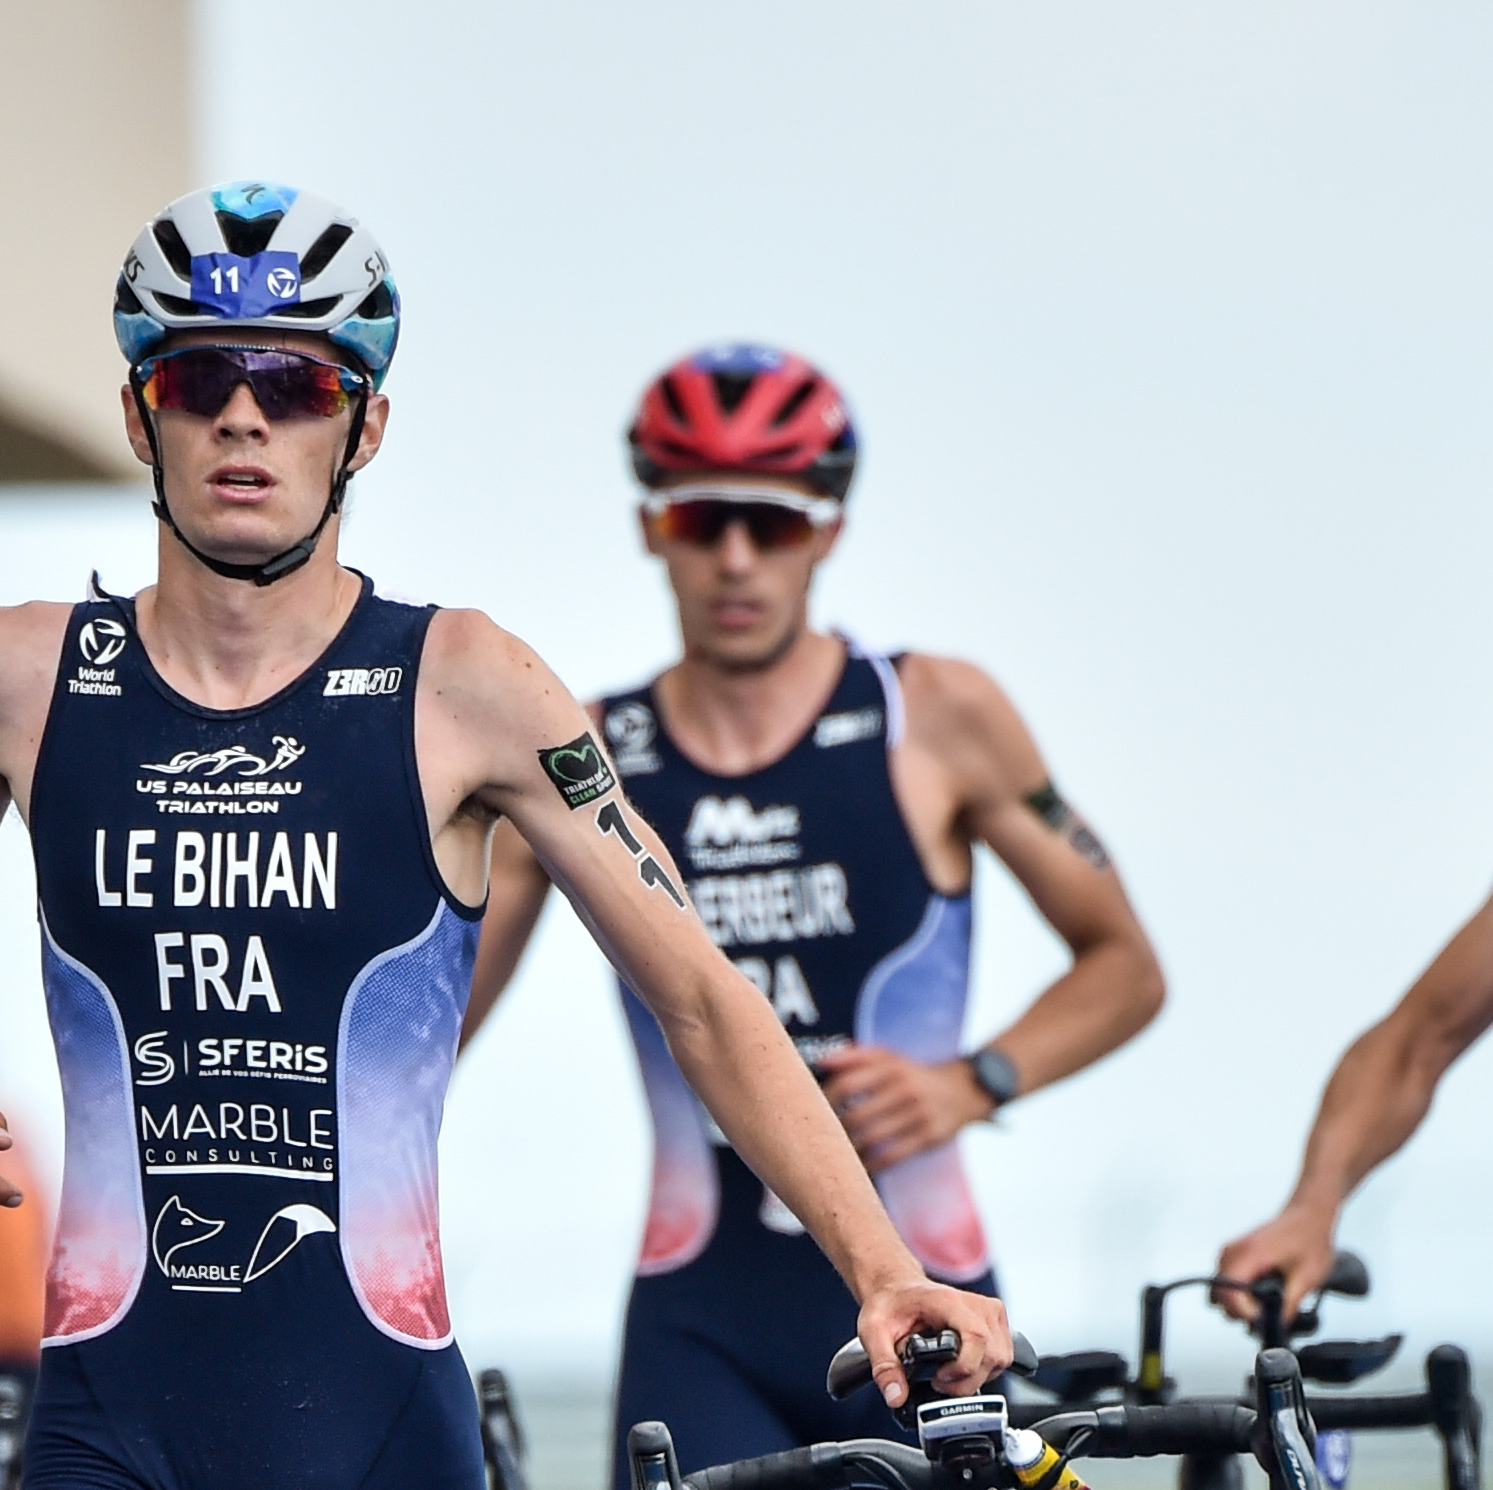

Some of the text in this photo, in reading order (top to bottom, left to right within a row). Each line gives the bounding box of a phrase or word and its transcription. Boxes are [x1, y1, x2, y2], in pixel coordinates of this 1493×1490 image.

[210, 266, 240, 295] 11
[78, 666, 116, 681] World
[68, 679, 122, 696] Triathlon
[136, 780, 303, 795] US PALAISEAU
[156, 800, 280, 814] TRIATHLON
[594, 799, 687, 911] 11
[95, 829, 338, 909] LE BIHAN
[153, 931, 282, 1014] FRA
[141, 1102, 334, 1149] MARBLE
[145, 1148, 334, 1170] CONSULTING
[170, 1264, 241, 1281] MARBLE
[940, 1403, 984, 1416] GARMIN
